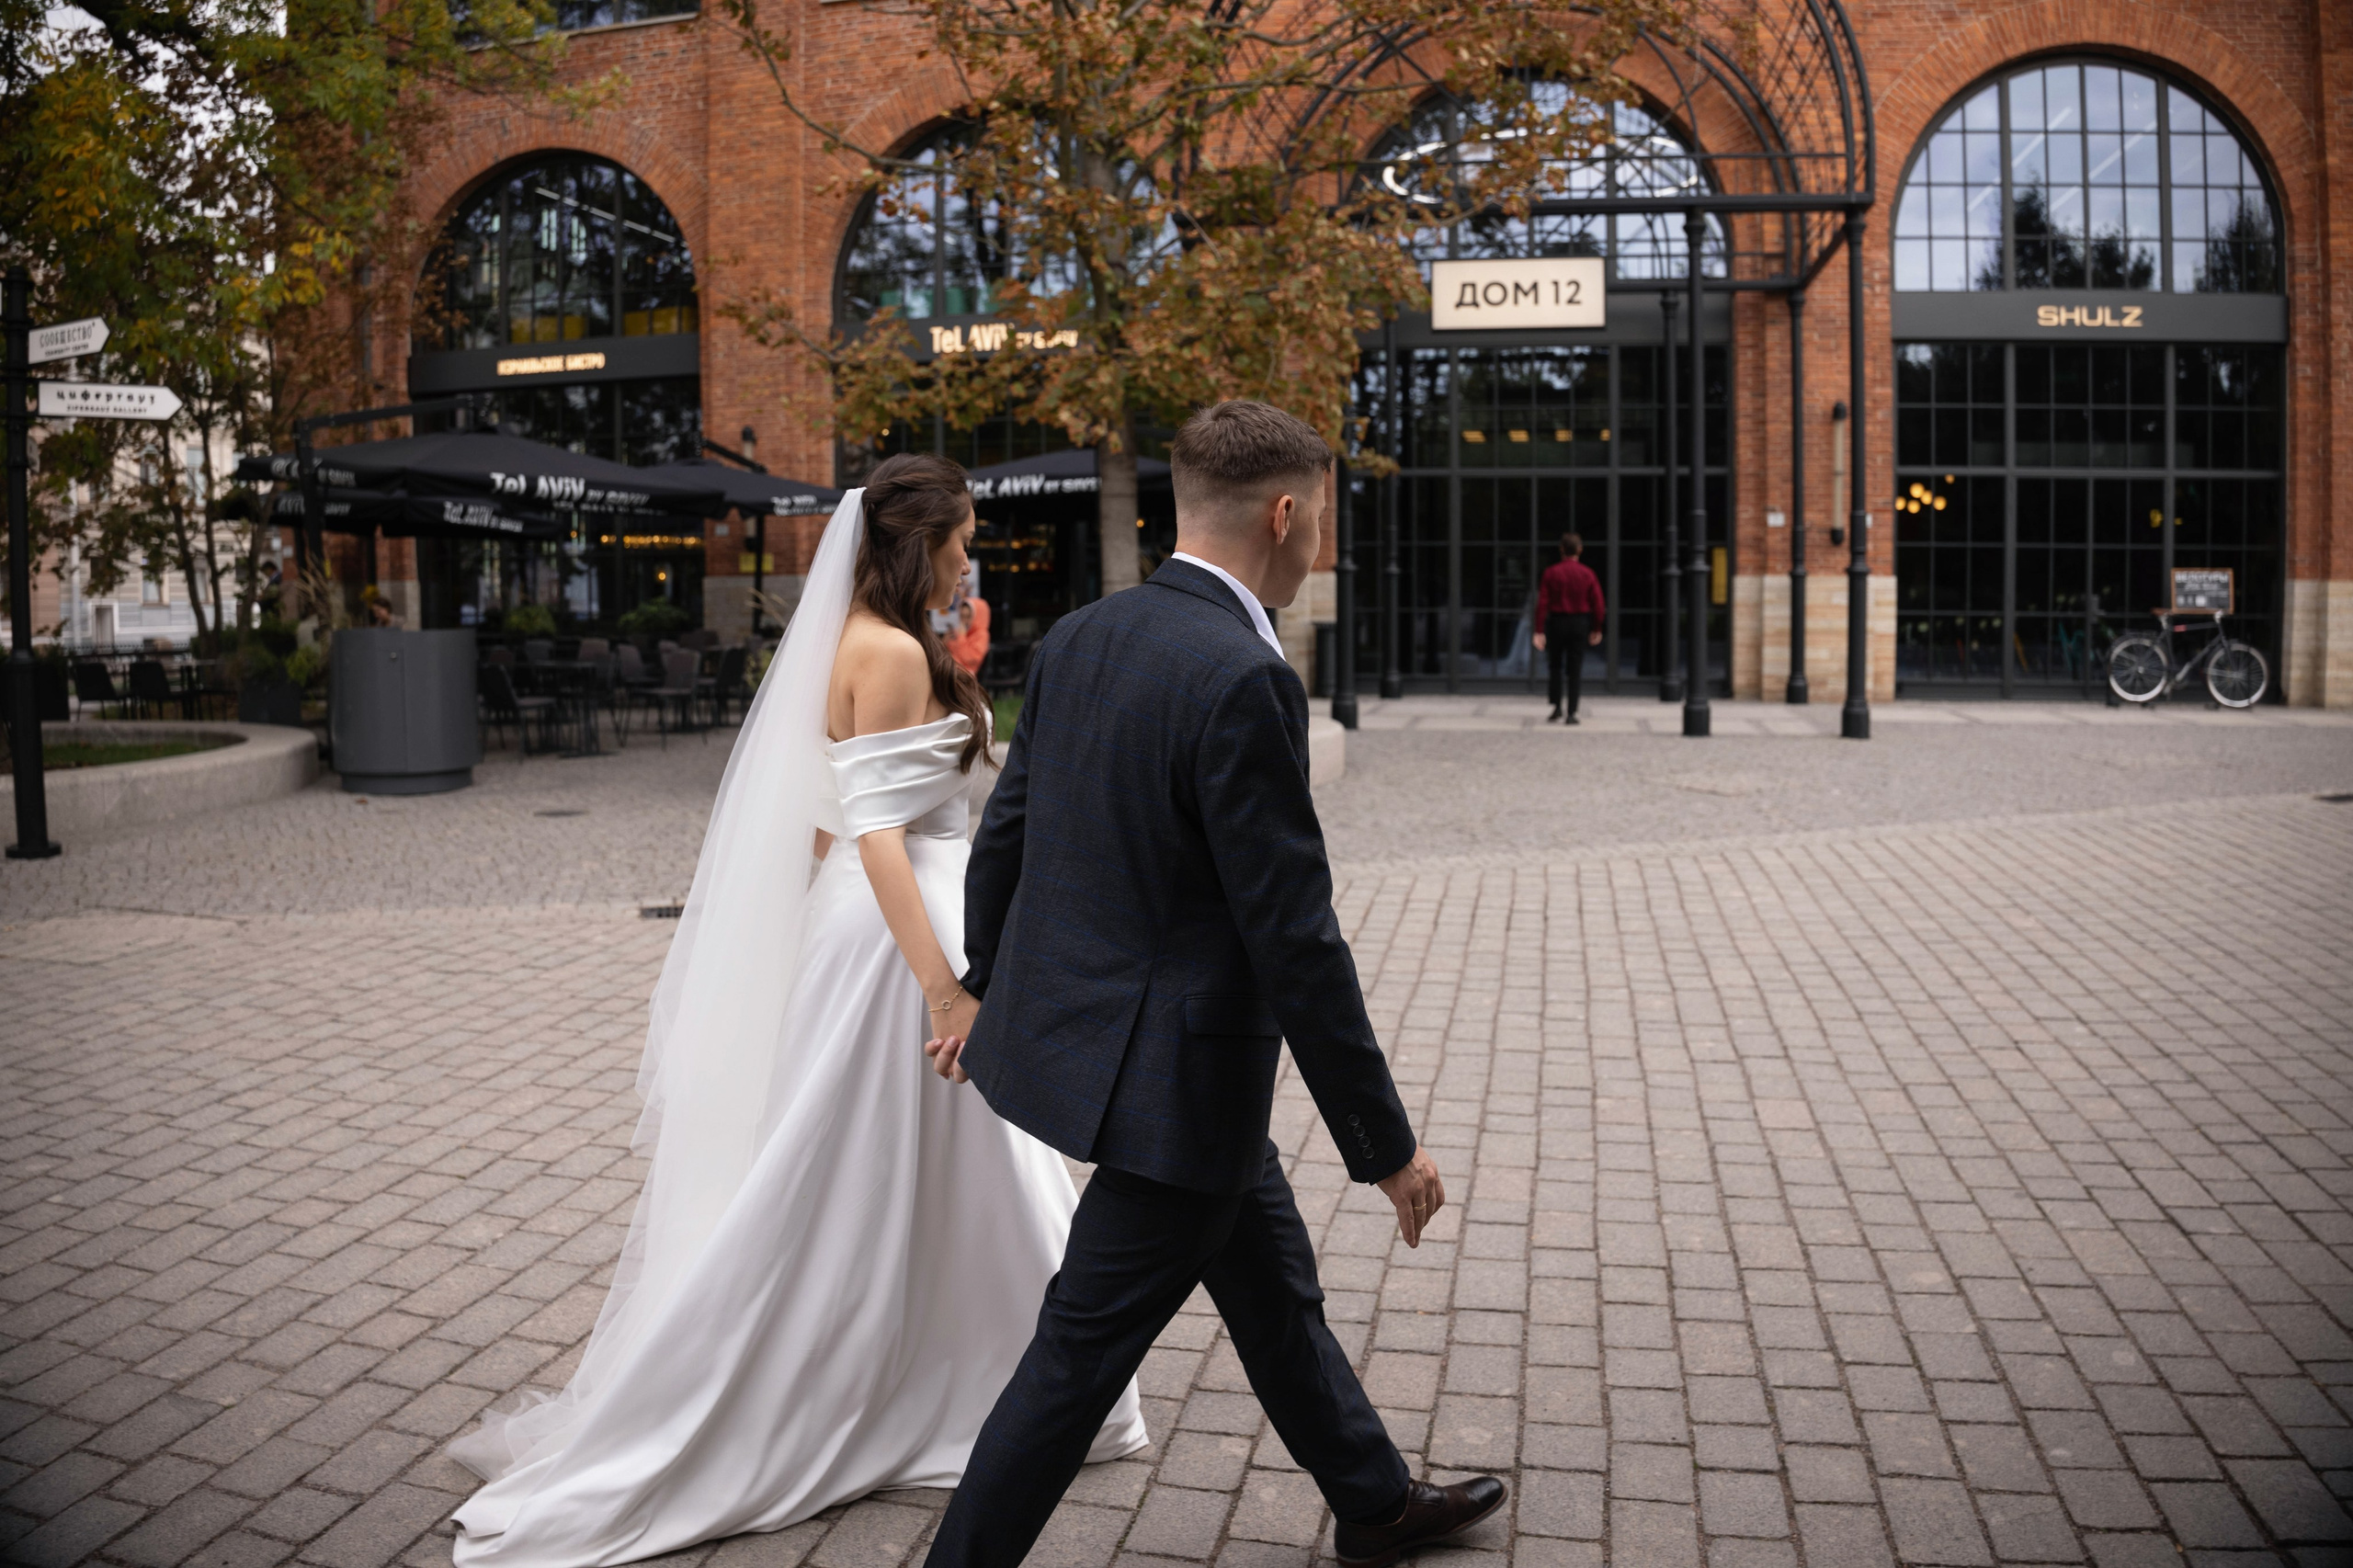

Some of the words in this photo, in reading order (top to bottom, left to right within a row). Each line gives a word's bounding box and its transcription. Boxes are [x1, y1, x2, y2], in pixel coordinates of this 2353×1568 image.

[1455, 280, 1540, 311] ДОМ
[1552, 279, 1583, 306] 12
[2037, 304, 2143, 327] SHULZ
